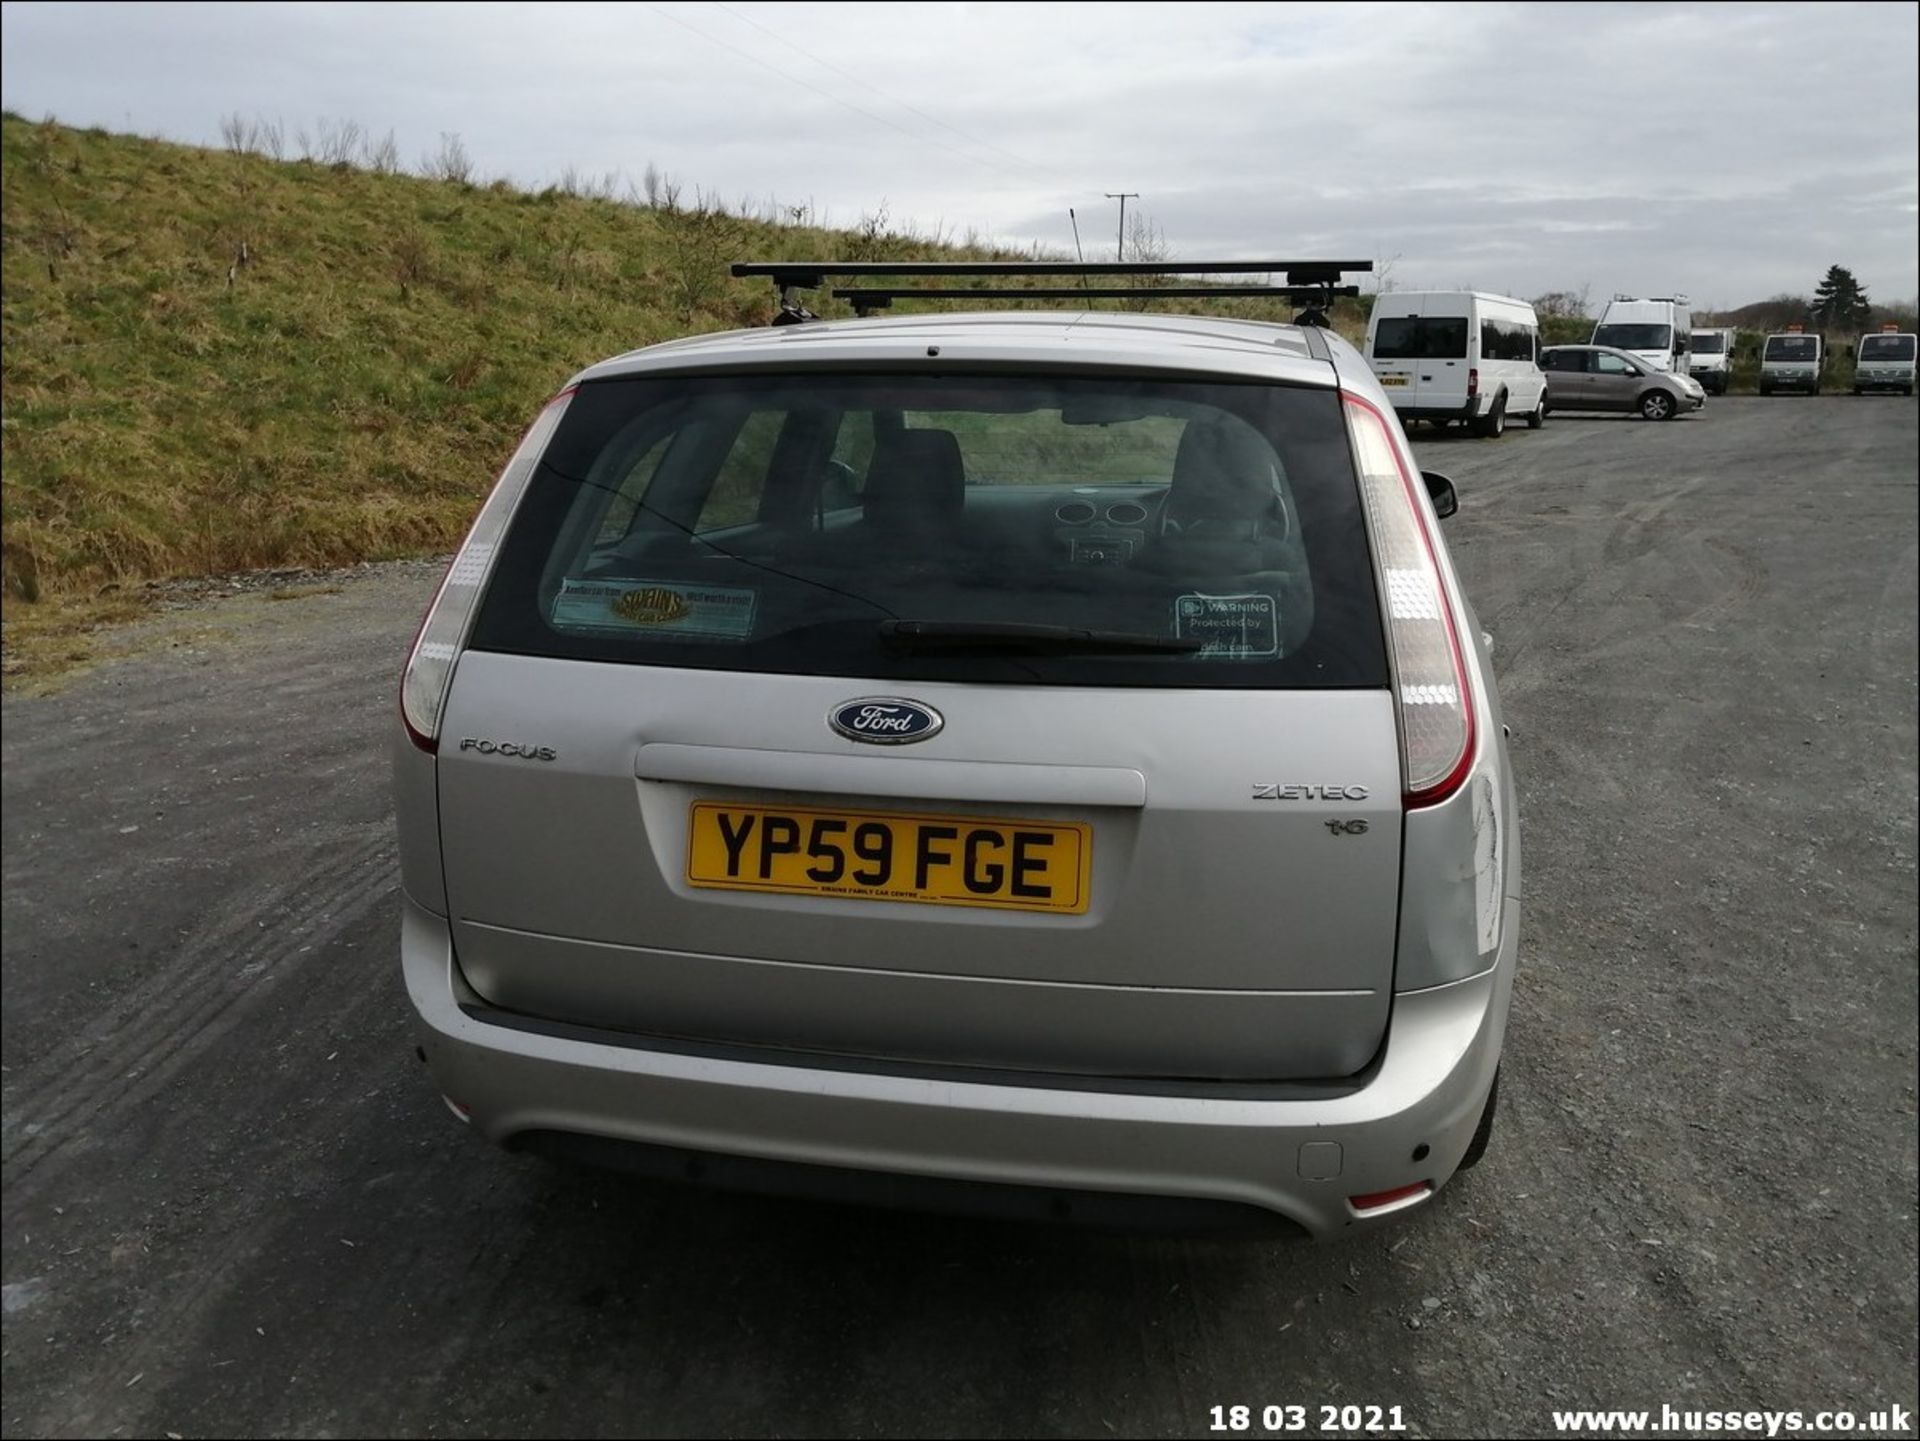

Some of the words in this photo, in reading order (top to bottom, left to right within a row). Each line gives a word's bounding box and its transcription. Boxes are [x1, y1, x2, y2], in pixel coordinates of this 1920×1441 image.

[1207, 602, 1269, 612] WARNING
[1190, 617, 1244, 627] Protected
[1246, 617, 1261, 629] by
[854, 705, 913, 731] Ford
[460, 737, 557, 761] FOCUS
[1252, 783, 1369, 801] ZETEC
[716, 812, 894, 885] YP59
[915, 825, 1055, 899] FGE
